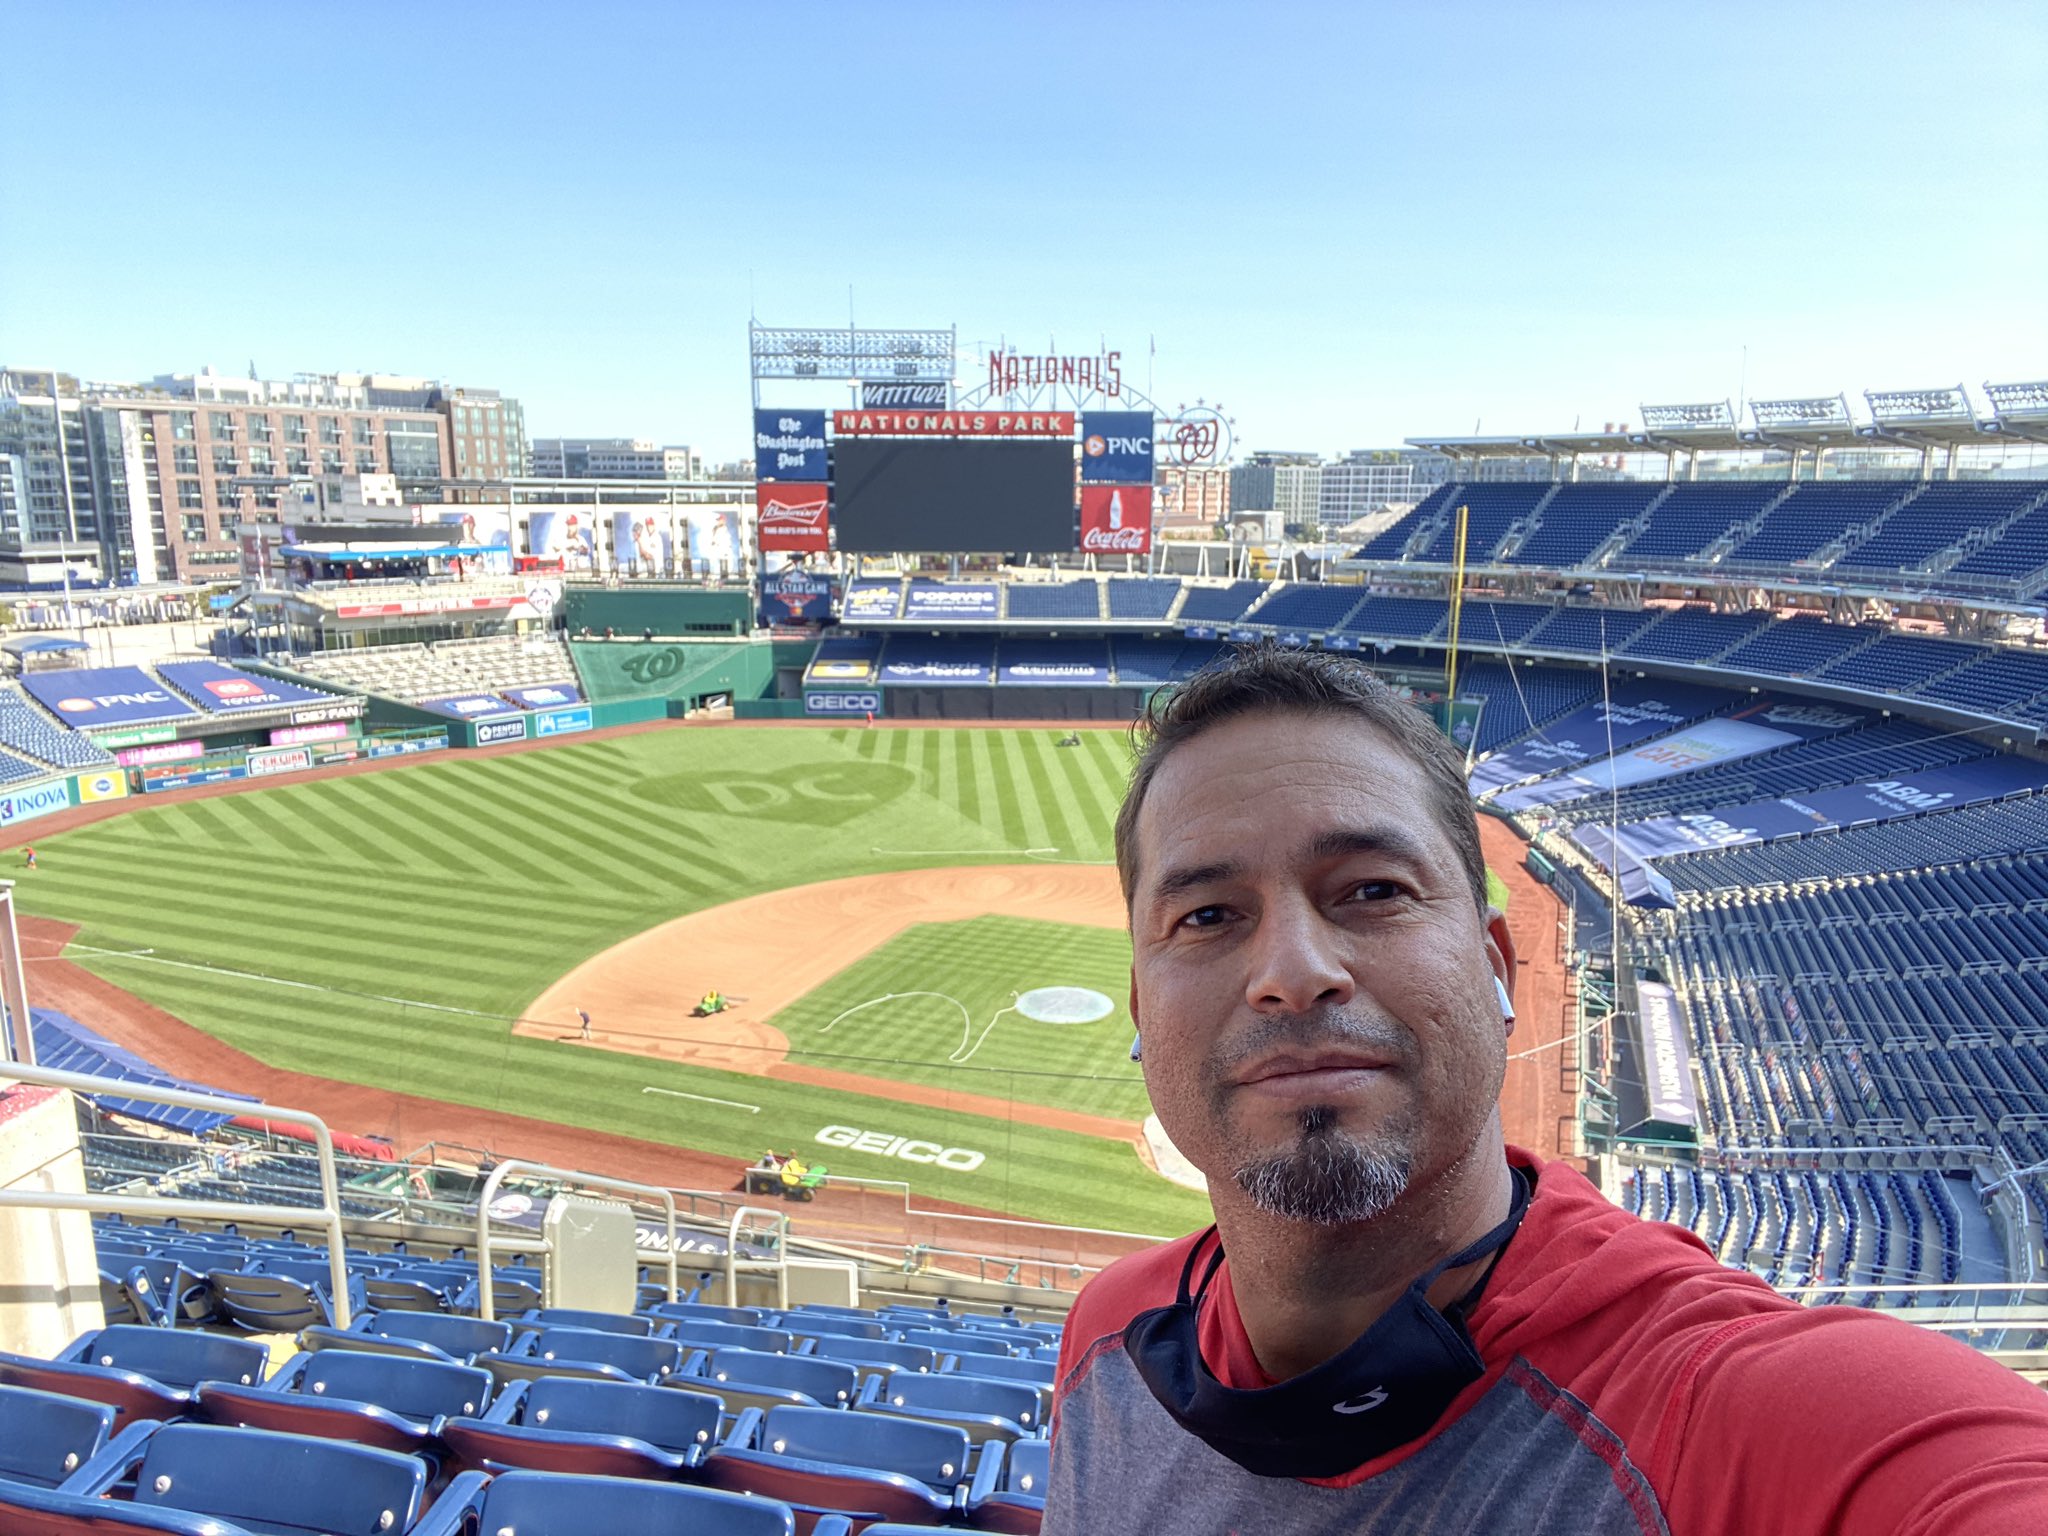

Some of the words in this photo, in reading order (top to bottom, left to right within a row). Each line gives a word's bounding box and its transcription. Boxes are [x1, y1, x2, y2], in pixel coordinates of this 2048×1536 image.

[990, 350, 1121, 397] NATIONALS
[863, 385, 947, 405] NATITUDE
[778, 417, 802, 433] The
[841, 415, 987, 431] NATIONALS
[998, 416, 1063, 431] PARK
[757, 433, 825, 452] Washington
[1107, 437, 1150, 455] PNC
[777, 452, 806, 470] Post
[92, 691, 170, 708] PNC
[219, 693, 281, 707] TOYOTA
[808, 693, 877, 711] GEICO
[328, 705, 360, 720] FAN
[16, 786, 67, 814] INOVA
[701, 772, 877, 812] DC
[1865, 781, 1944, 808] ABM
[814, 1125, 986, 1172] GEICO
